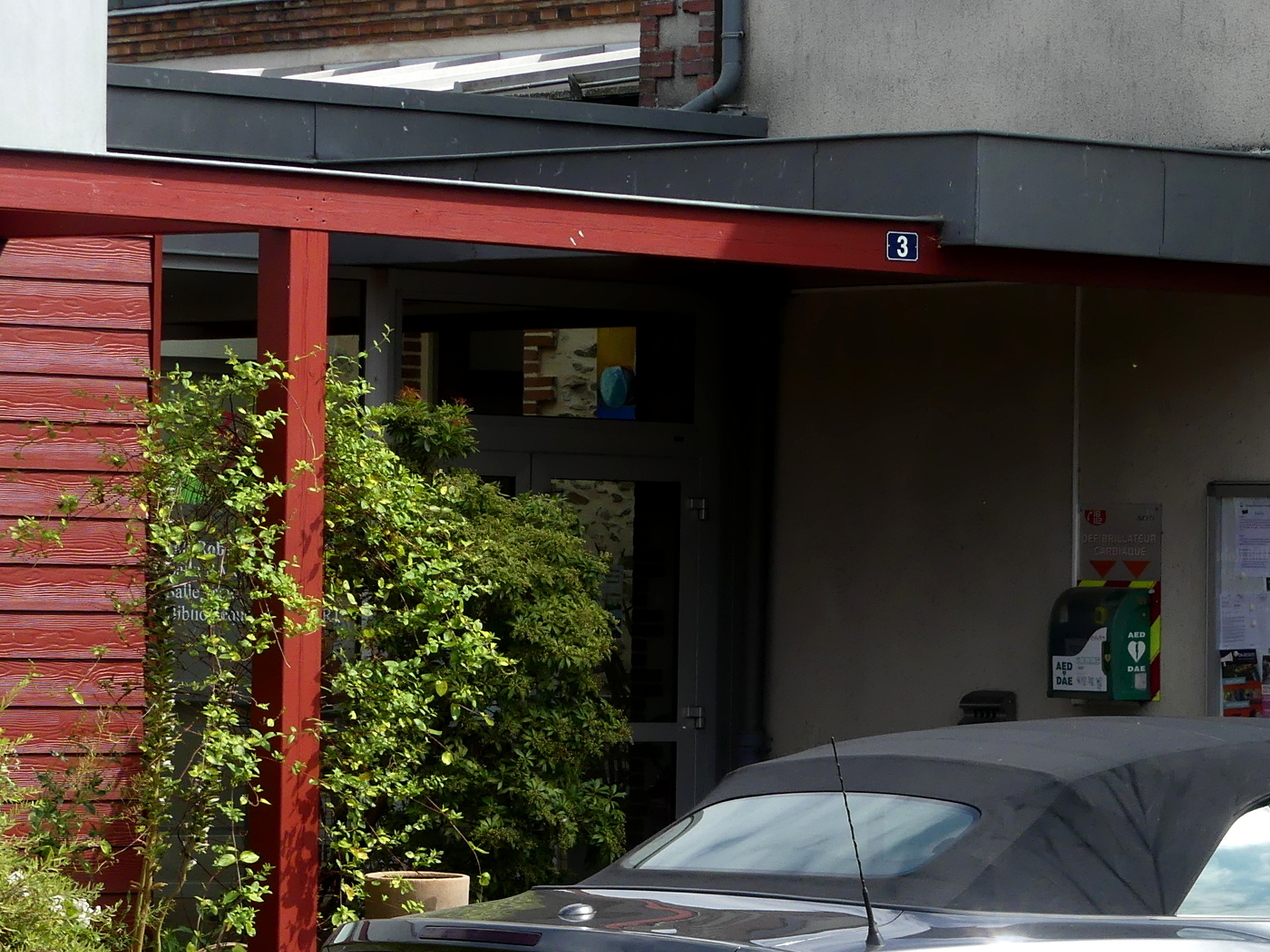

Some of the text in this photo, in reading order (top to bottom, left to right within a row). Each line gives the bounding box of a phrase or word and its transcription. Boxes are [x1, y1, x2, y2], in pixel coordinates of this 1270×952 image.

[896, 235, 909, 258] 3
[1094, 546, 1147, 556] CARDIAQUE
[1127, 631, 1146, 639] AED
[1056, 662, 1073, 671] AED
[1056, 677, 1073, 686] DAE
